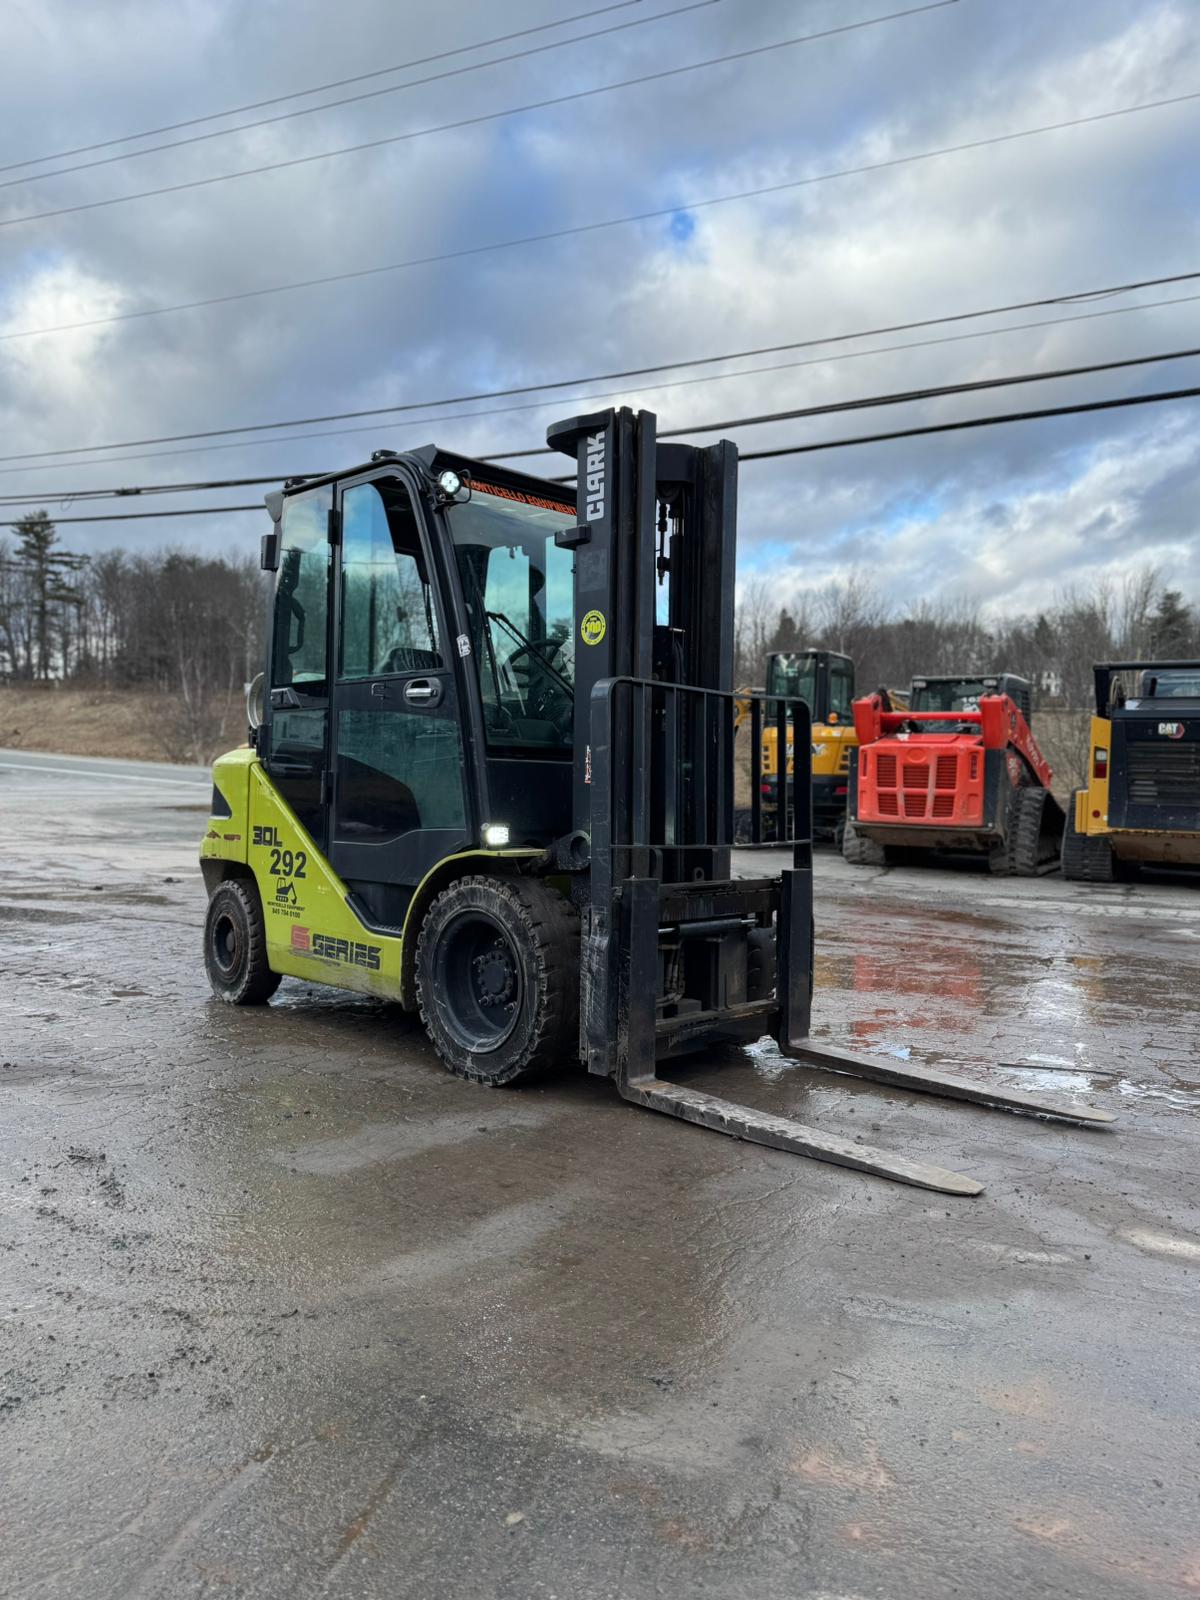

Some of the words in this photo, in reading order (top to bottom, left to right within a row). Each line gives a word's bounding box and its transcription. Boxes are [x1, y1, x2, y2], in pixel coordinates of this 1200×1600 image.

[587, 431, 605, 521] CLARK
[1158, 722, 1178, 735] CAT
[253, 826, 283, 847] 30L
[270, 849, 306, 878] 292
[313, 933, 381, 970] SERIES
